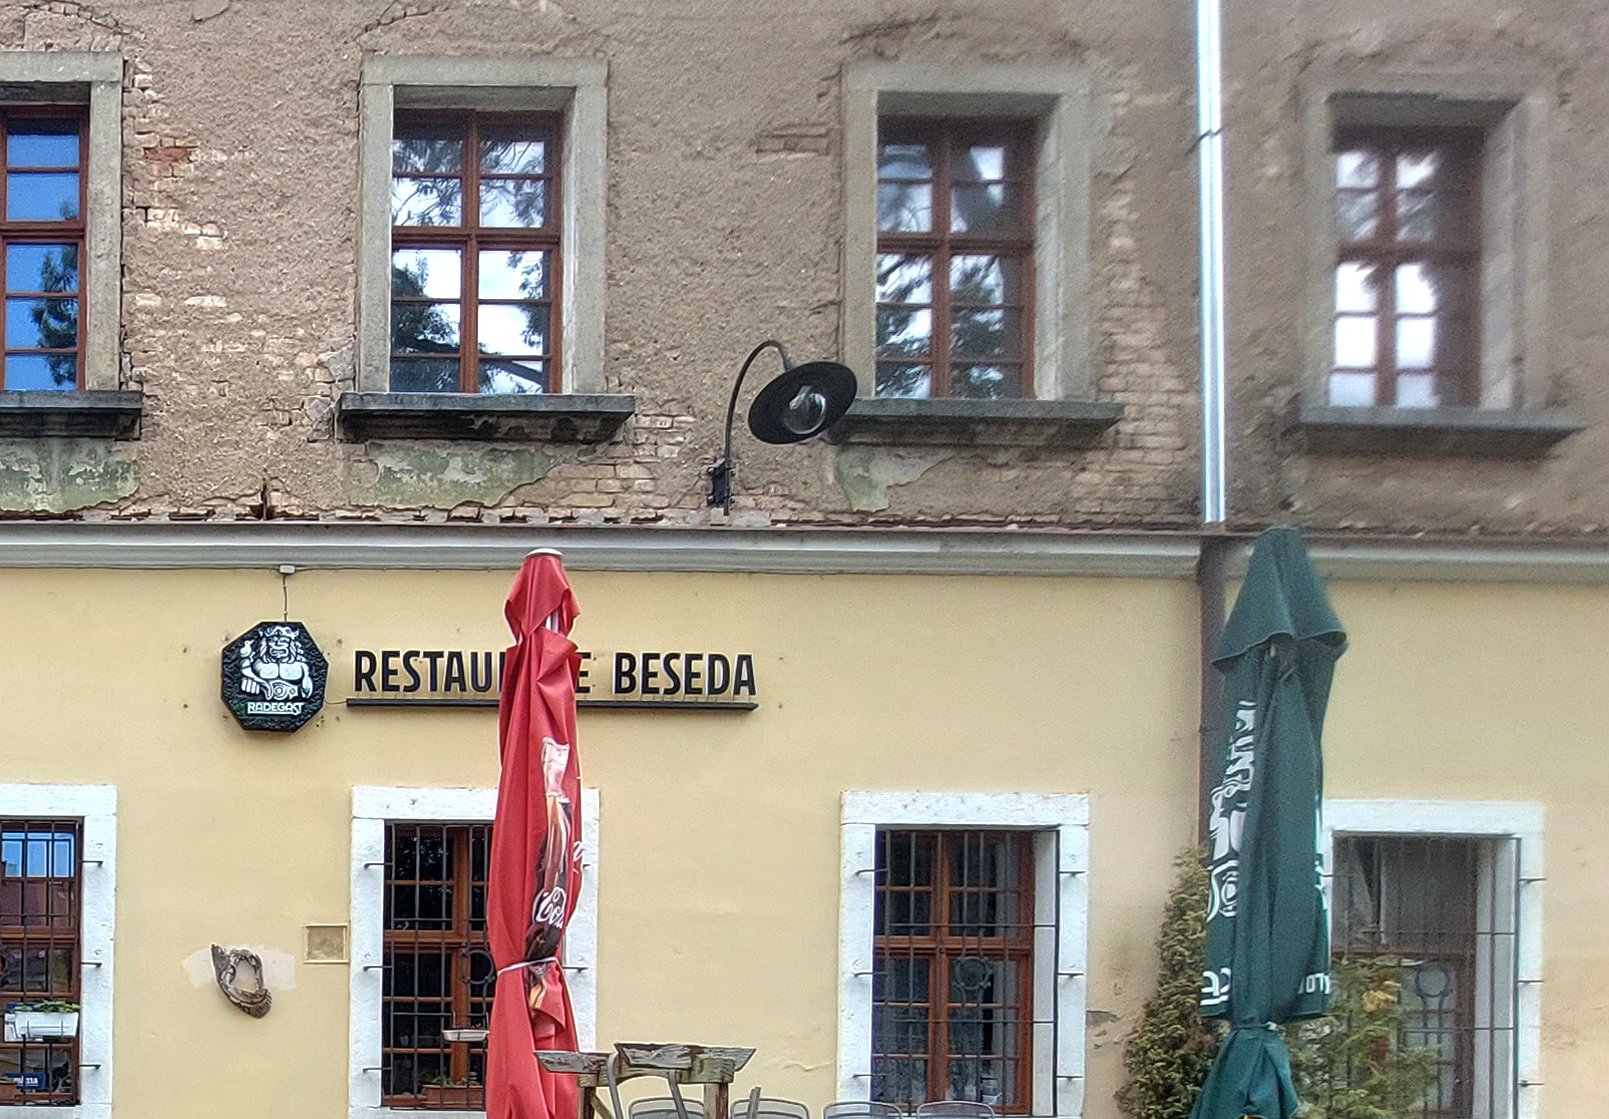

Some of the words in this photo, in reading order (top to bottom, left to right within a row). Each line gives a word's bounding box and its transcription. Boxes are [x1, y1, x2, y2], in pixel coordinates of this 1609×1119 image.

[354, 650, 592, 693] RESTAUE
[613, 652, 757, 696] BESEDA
[247, 702, 306, 715] RADEGAST
